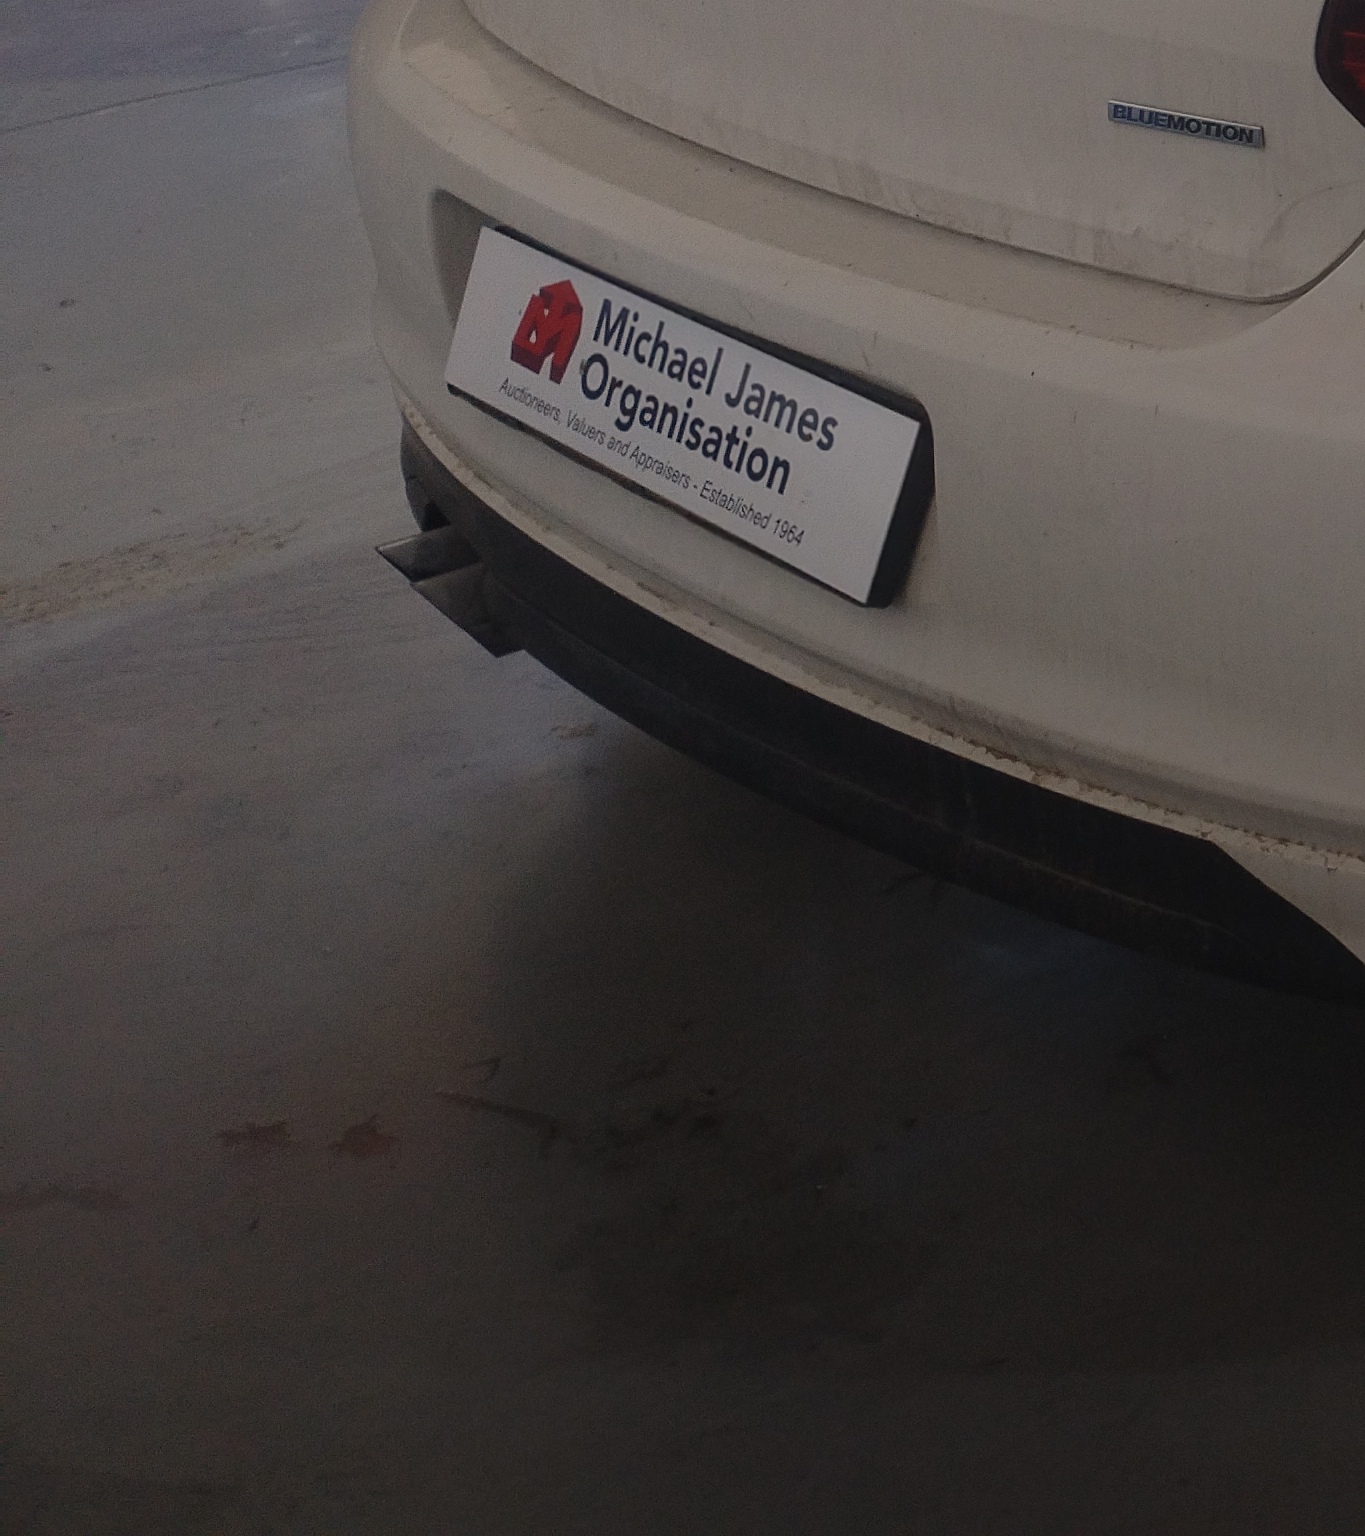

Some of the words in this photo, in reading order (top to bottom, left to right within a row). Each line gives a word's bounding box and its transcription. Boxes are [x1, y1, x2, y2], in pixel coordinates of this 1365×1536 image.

[1112, 104, 1254, 144] BLUEMOTION
[580, 352, 791, 495] Organisation
[592, 298, 724, 396] Michael
[725, 362, 839, 452] James
[499, 378, 562, 425] Auctioneers,
[566, 410, 606, 446] Valuers
[606, 435, 631, 457] and
[629, 445, 692, 489] Appraisers
[699, 480, 773, 529] Established
[772, 518, 805, 547] 1964
